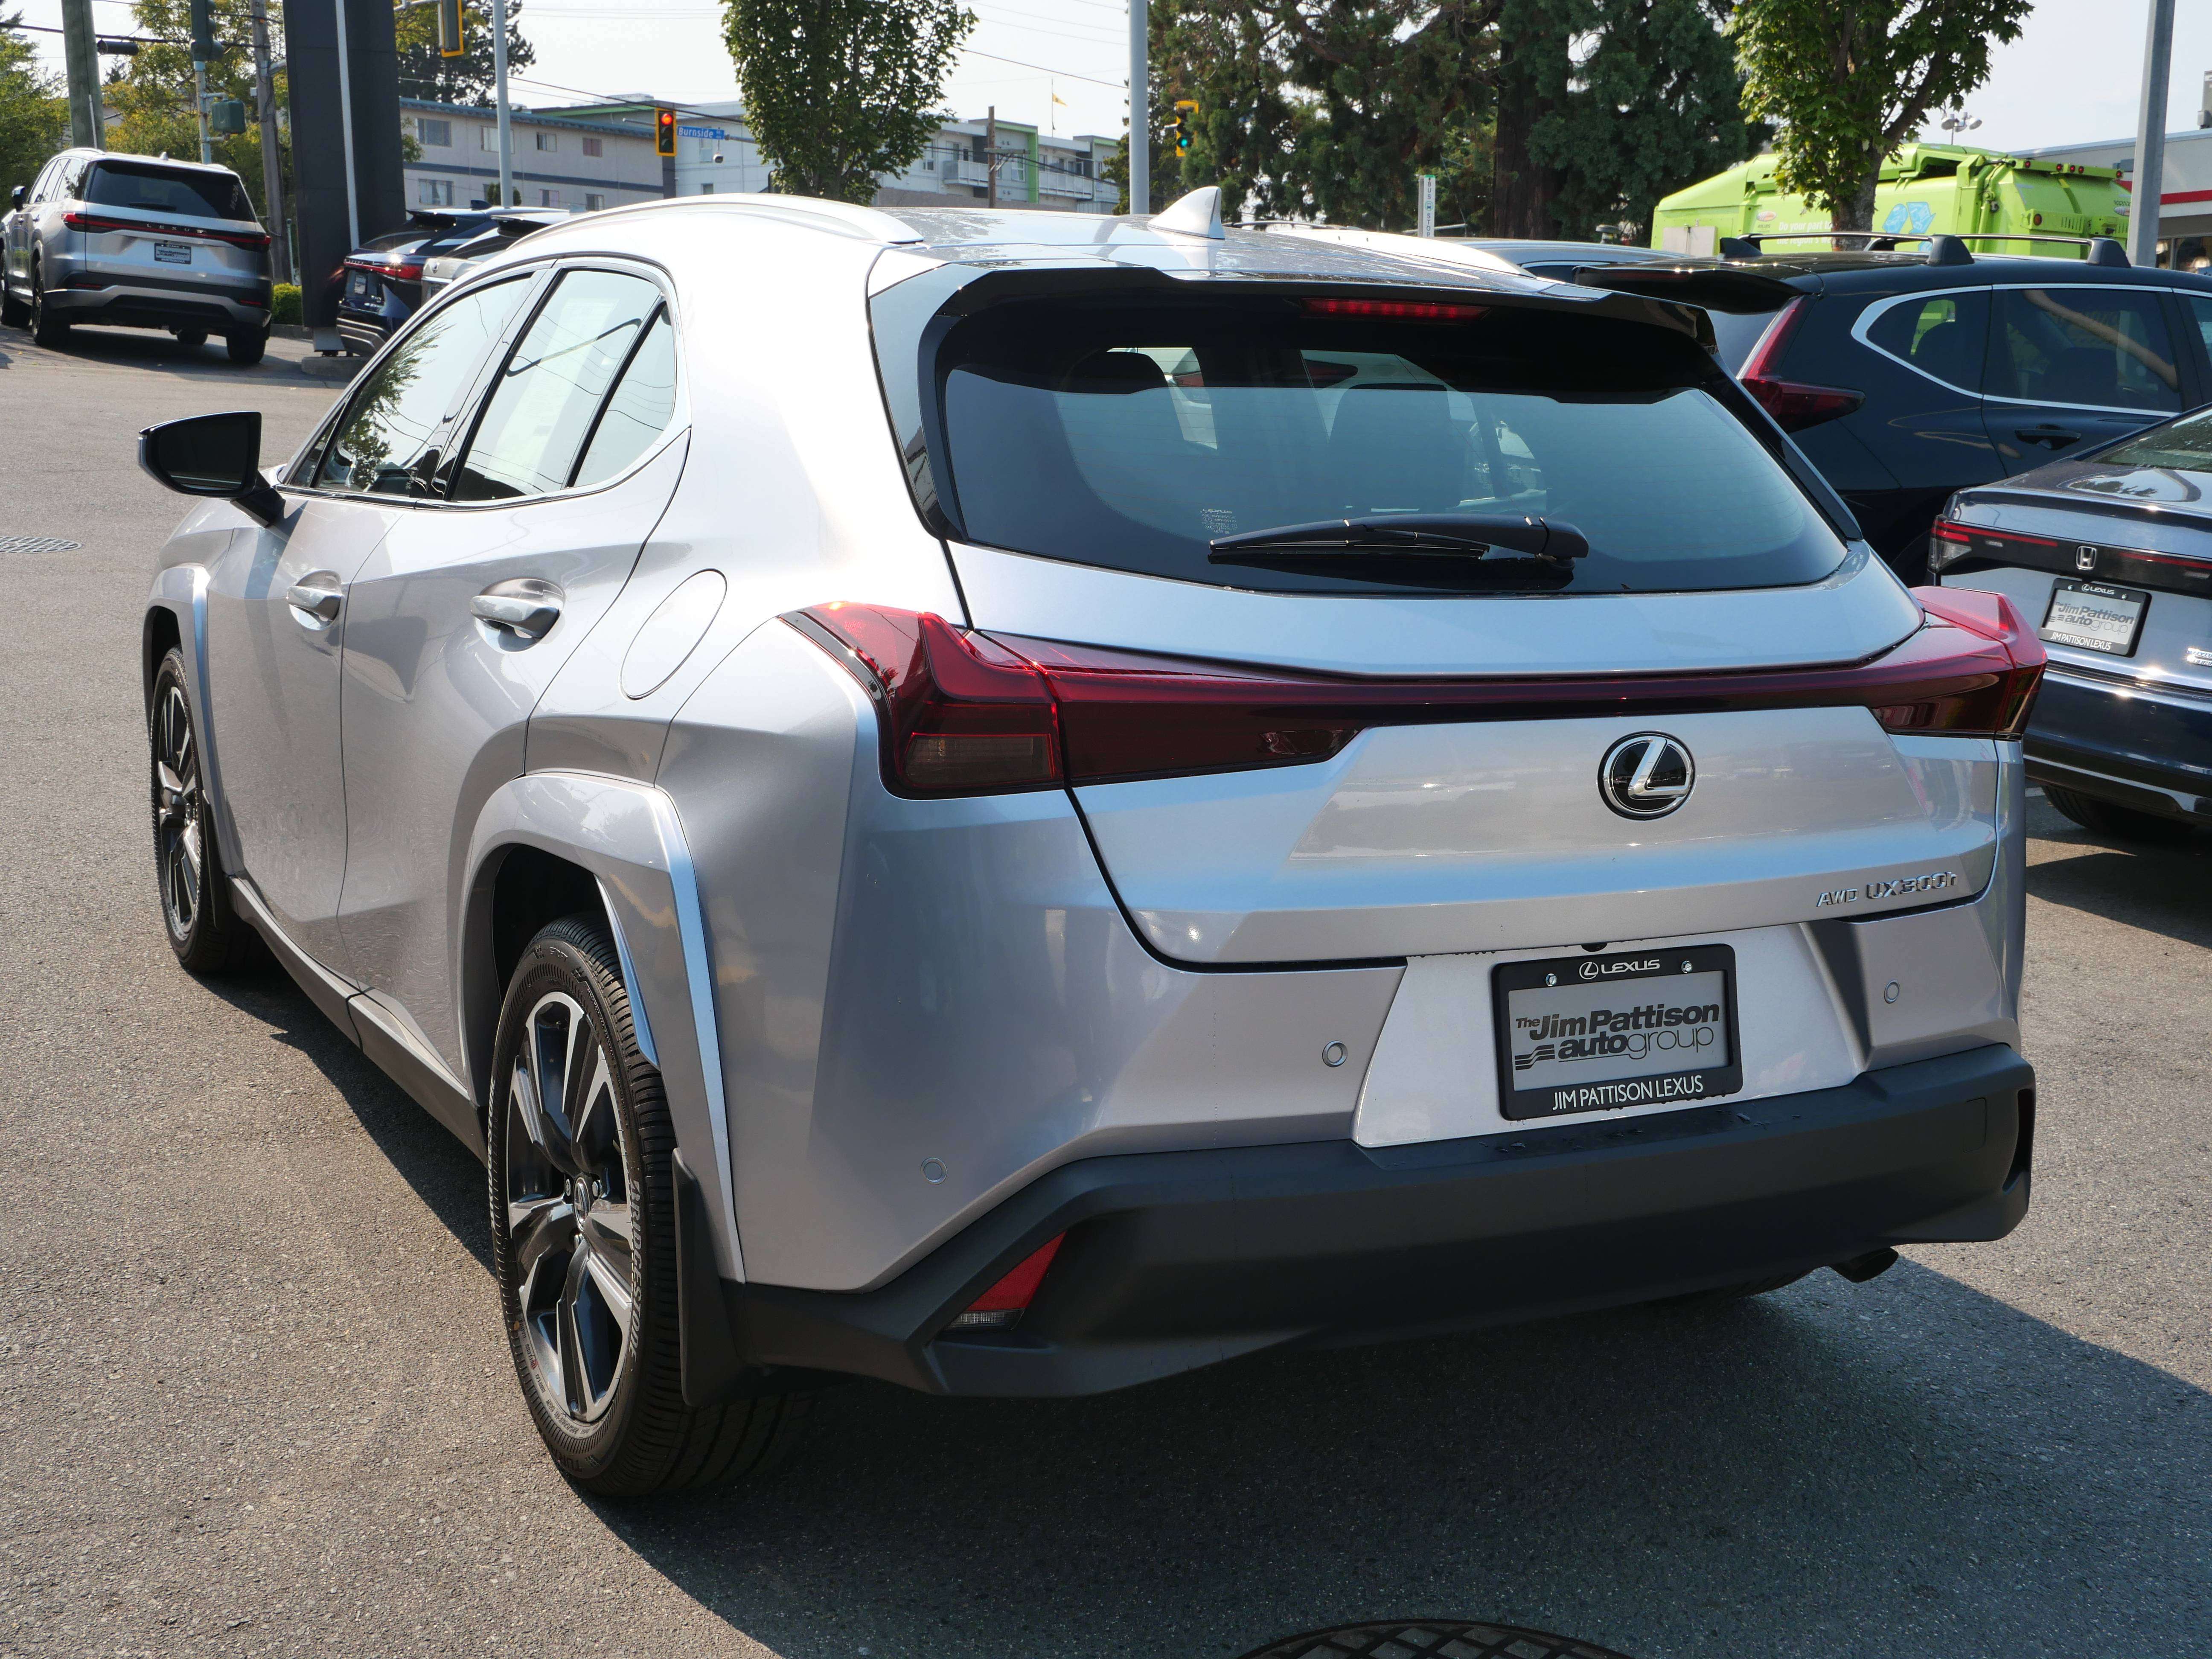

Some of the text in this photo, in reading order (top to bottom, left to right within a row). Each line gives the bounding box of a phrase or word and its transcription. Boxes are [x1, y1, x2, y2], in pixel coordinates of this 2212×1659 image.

[678, 127, 713, 138] Burnside
[1779, 221, 1788, 230] Do
[1790, 223, 1806, 233] your
[1806, 221, 1823, 233] part
[2058, 604, 2080, 614] Jim
[2079, 606, 2134, 624] Pattison
[2051, 632, 2112, 651] JIM PATTISON LEXUS
[1816, 871, 1958, 907] AWD UX300h
[1601, 959, 1660, 974] LEXUS
[1516, 1004, 1720, 1041] The Jim Pattison
[1552, 1075, 1703, 1110] JIM PATTISON LEXUS
[629, 1178, 642, 1363] BRIDGESTONE
